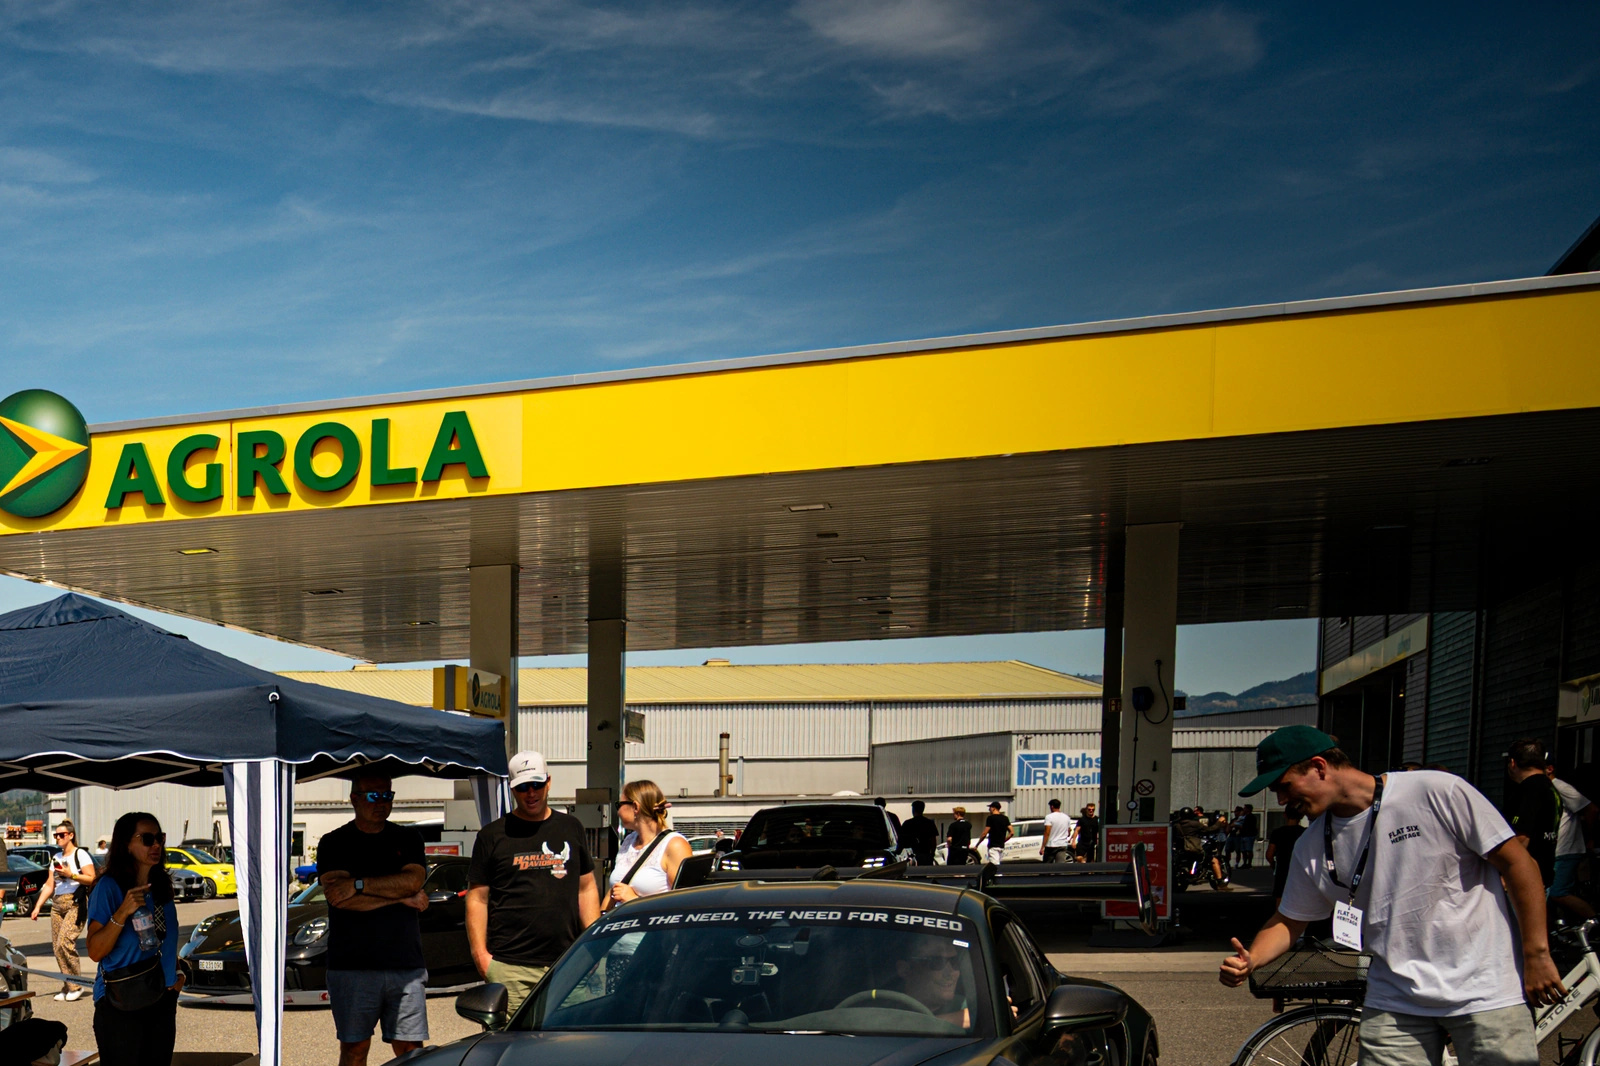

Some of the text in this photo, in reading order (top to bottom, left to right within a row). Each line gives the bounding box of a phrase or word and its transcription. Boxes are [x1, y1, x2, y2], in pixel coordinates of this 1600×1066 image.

[105, 411, 491, 510] AGROLA
[480, 691, 501, 711] AGROLA
[588, 742, 593, 750] 5
[614, 741, 620, 750] 6
[571, 805, 576, 813] 3
[1388, 825, 1420, 839] FLAT SIX
[1390, 831, 1421, 845] HERITAGE
[1108, 843, 1129, 853] CHF
[1337, 909, 1359, 922] FLAT SIX
[1337, 916, 1358, 926] HERITAGE
[592, 911, 963, 935] I FEEL THE NEED, THE NEED FOR SPEED
